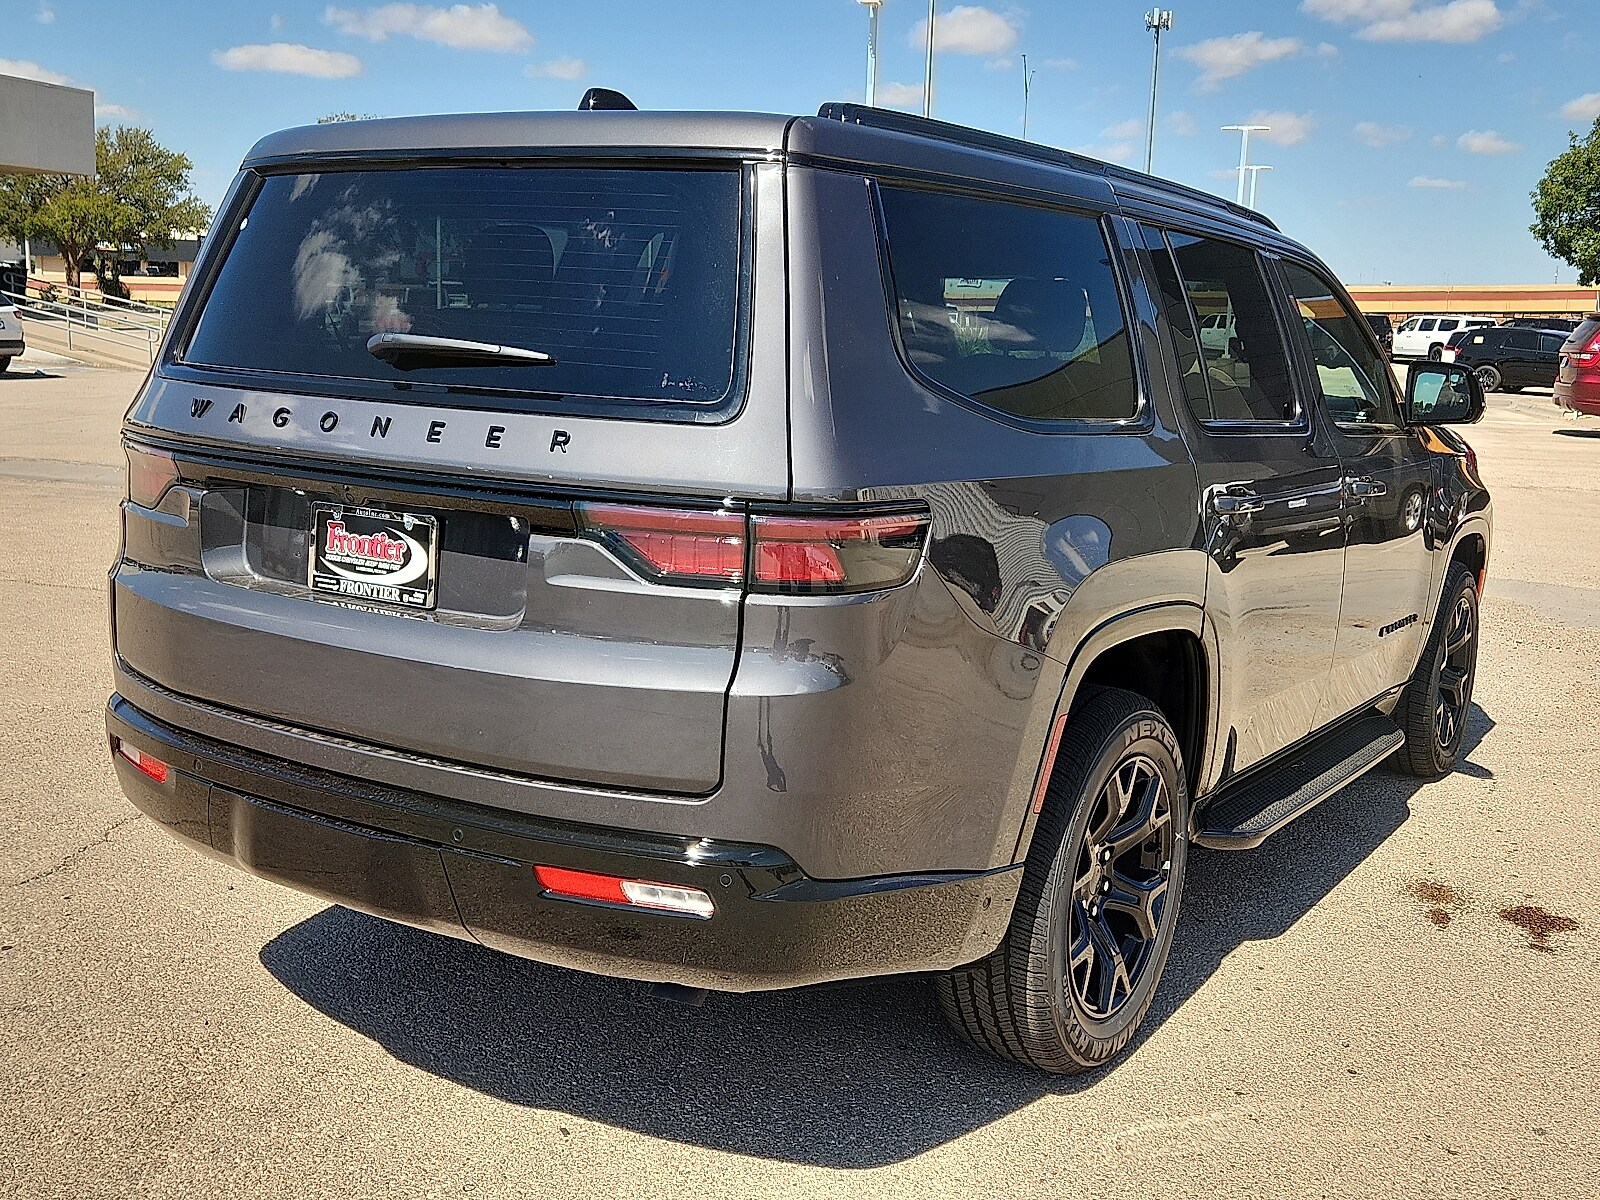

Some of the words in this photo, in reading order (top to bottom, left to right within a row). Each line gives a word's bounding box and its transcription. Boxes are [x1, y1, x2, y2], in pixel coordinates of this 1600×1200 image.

[190, 397, 572, 453] WAGONEER
[326, 521, 405, 562] Frontier
[339, 579, 401, 602] FRONTIER
[1123, 719, 1182, 772] NEXEN
